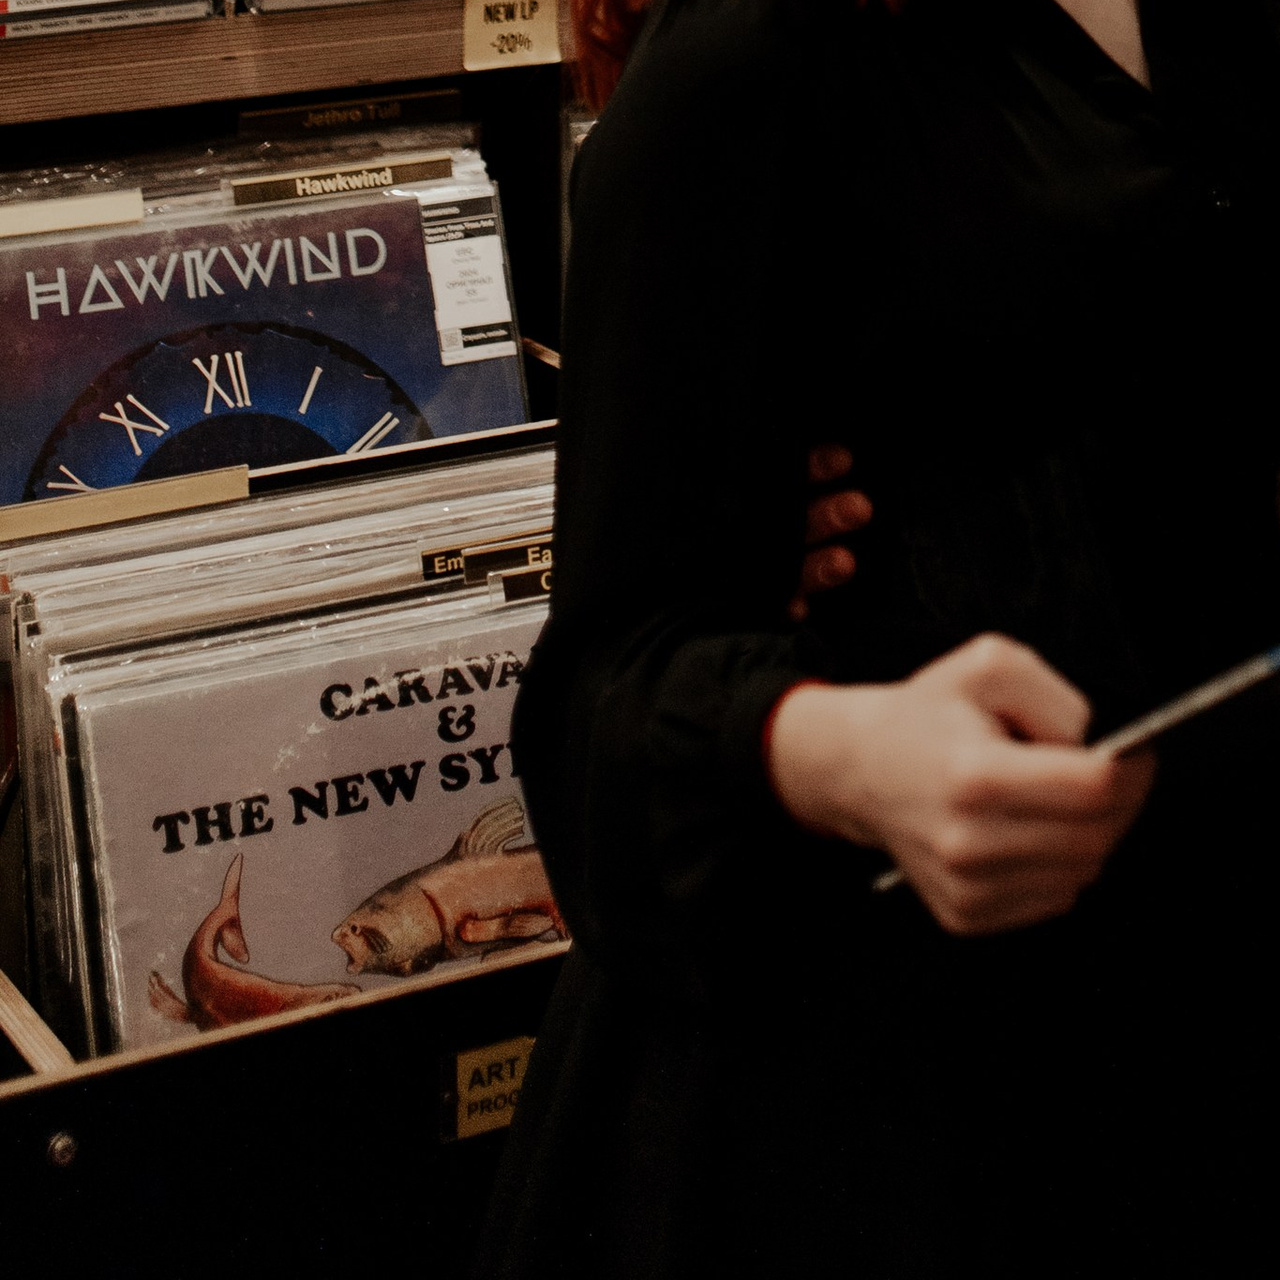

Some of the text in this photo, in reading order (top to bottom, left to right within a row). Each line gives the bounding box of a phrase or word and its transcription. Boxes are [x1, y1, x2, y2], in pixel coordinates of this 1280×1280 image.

[484, 0, 540, 24] NEW LP
[303, 107, 363, 129] Jethro
[295, 167, 393, 197] Hawkwind
[26, 227, 388, 320] HAWKWIND
[438, 704, 476, 743] &
[153, 794, 274, 854] THE
[288, 760, 426, 826] NEW
[468, 1056, 519, 1091] ART
